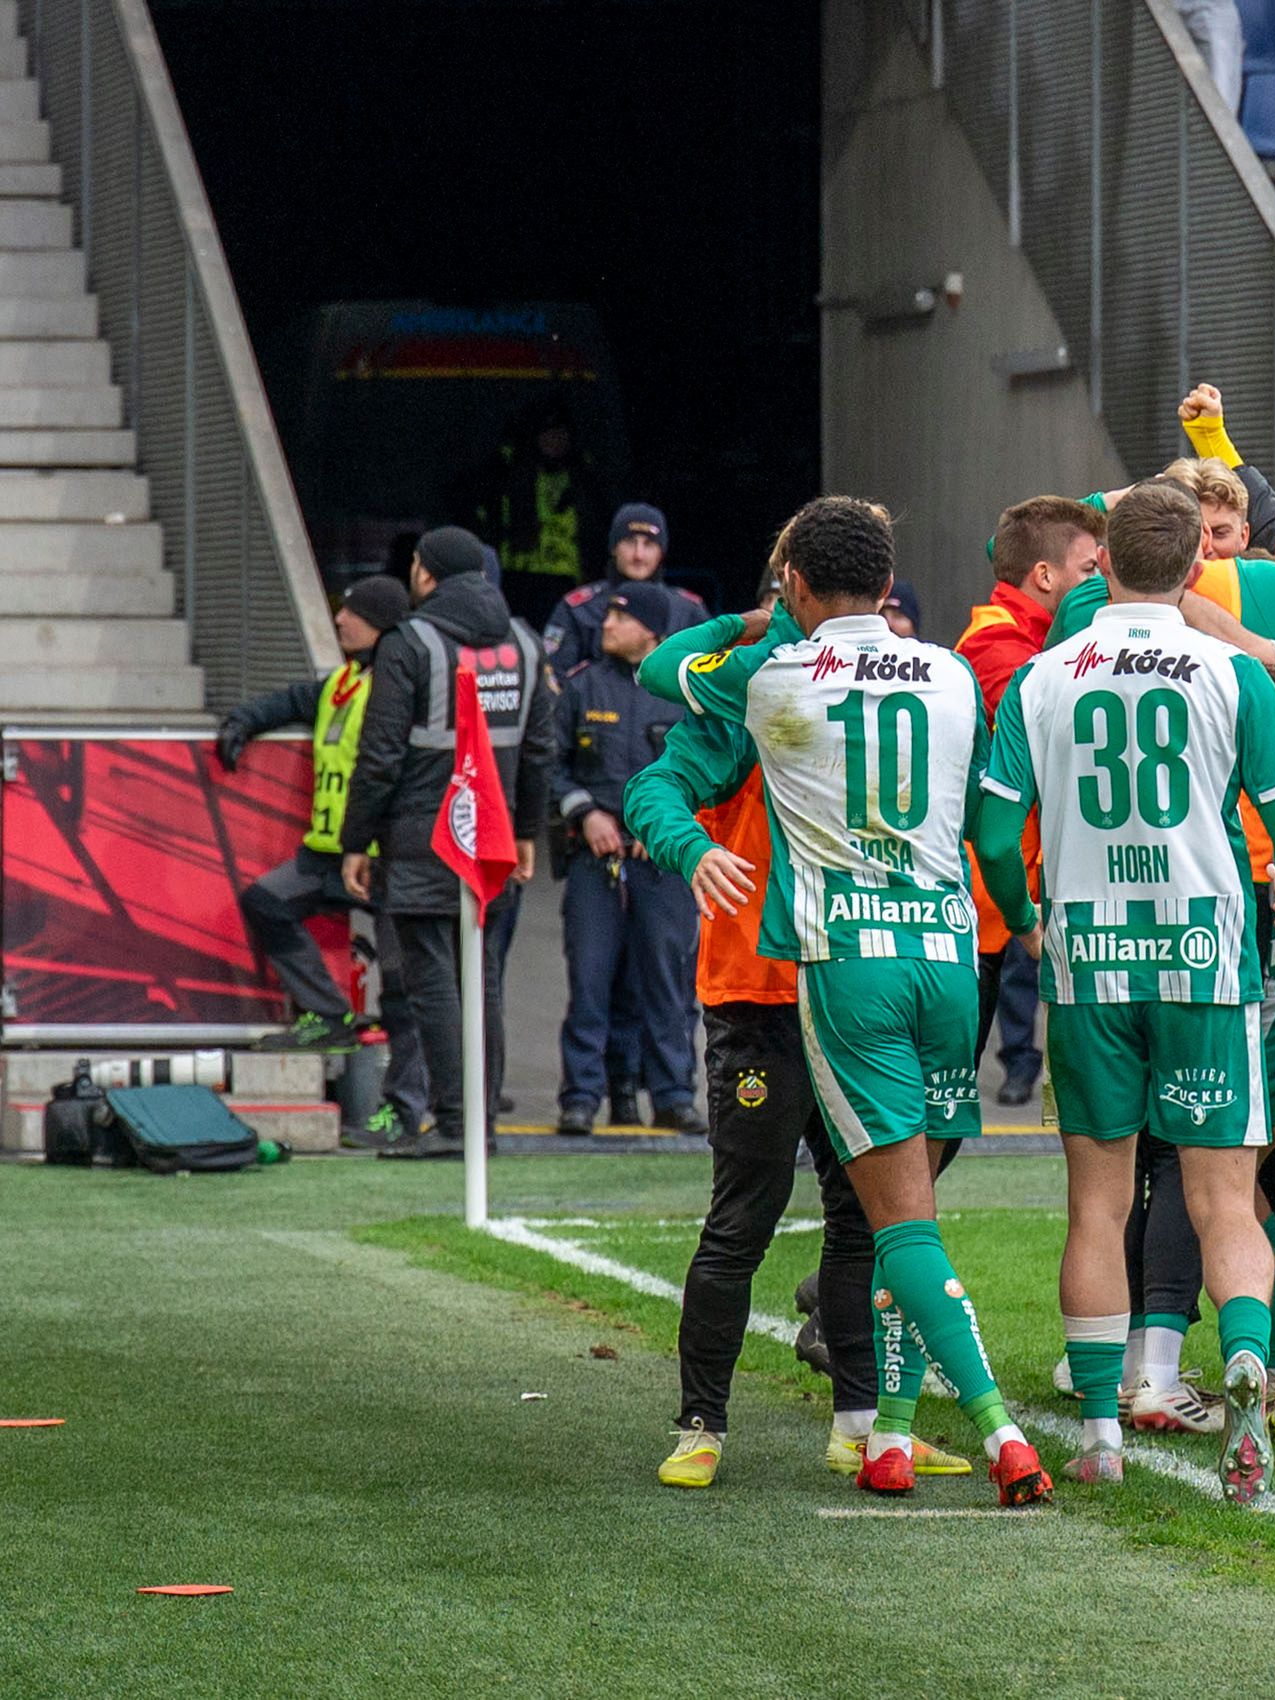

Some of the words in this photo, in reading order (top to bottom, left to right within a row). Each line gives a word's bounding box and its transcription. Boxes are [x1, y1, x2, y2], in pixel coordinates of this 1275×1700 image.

[854, 653, 932, 683] köck
[1112, 648, 1201, 684] köck
[827, 689, 929, 831] 10
[1074, 688, 1191, 830] 38
[1107, 844, 1170, 884] HORN
[827, 893, 938, 924] Allianz
[1070, 934, 1172, 963] Allianz
[1174, 1067, 1226, 1085] WIENER
[1160, 1083, 1235, 1106] ZUCKER
[880, 1310, 905, 1393] easystaff
